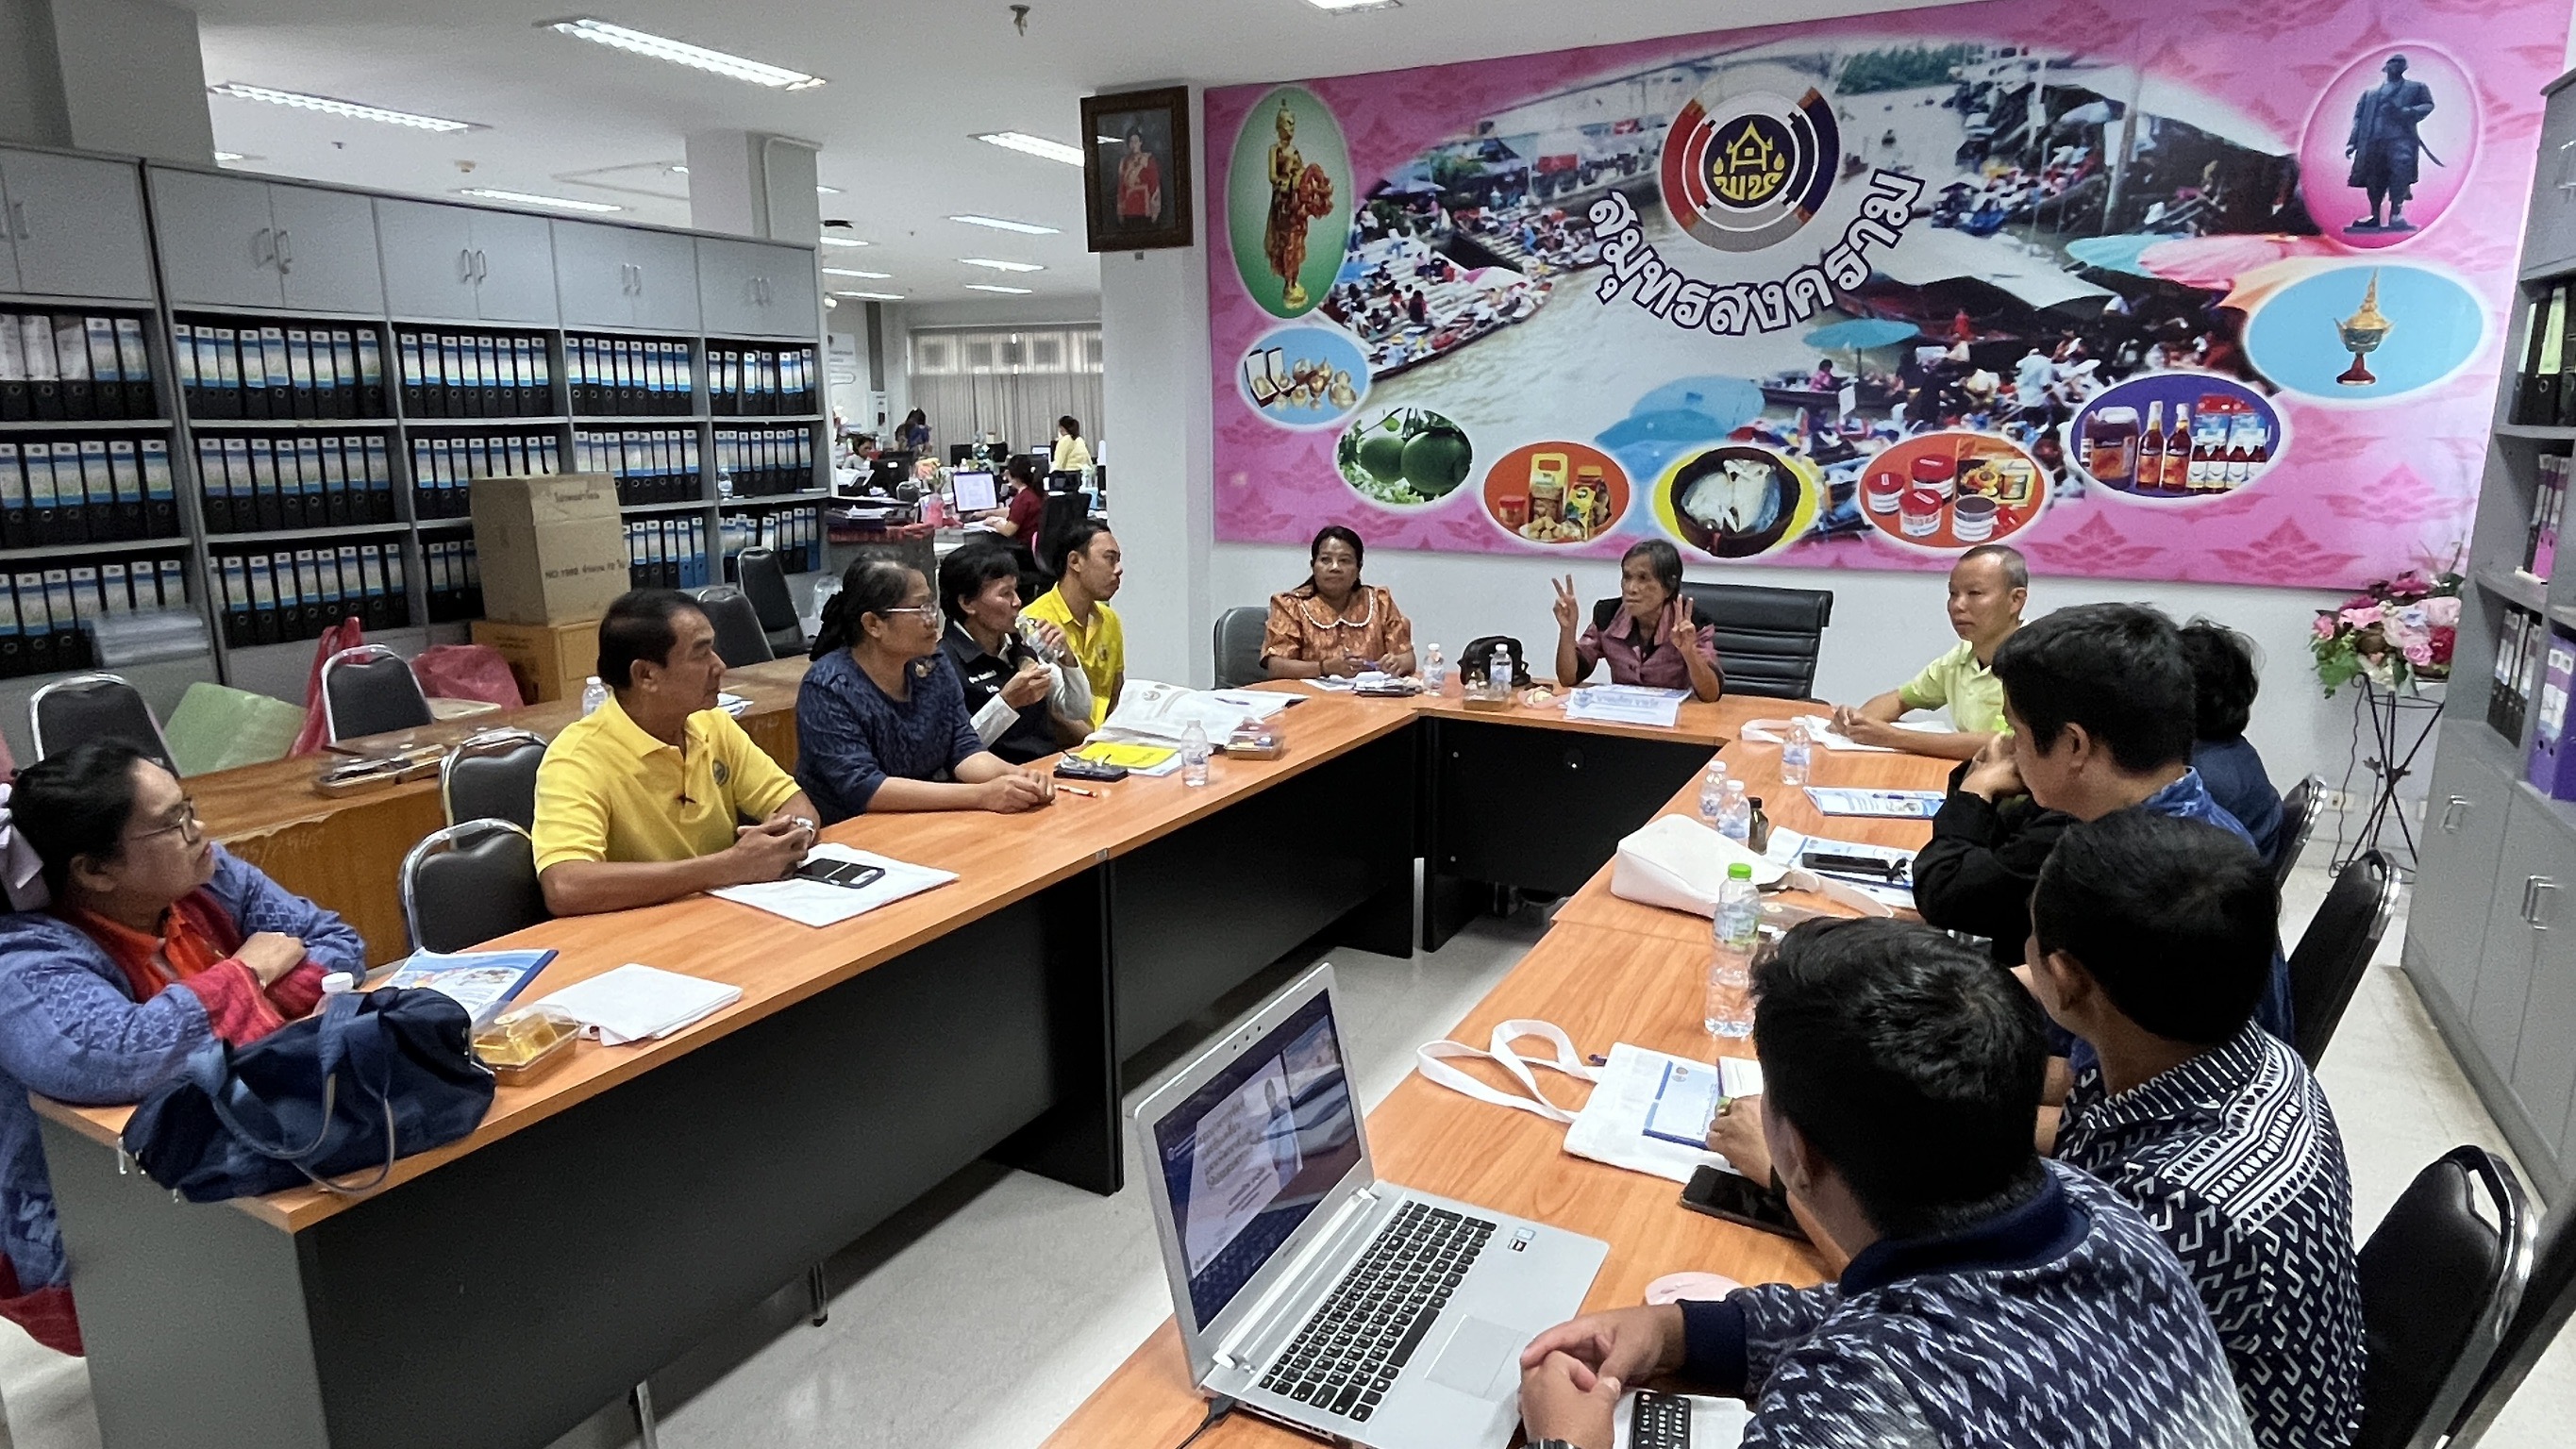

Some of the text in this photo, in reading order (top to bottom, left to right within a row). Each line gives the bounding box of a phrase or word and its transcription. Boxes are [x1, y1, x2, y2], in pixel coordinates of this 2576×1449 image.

[1589, 169, 1925, 335] สมุทรสงคราม
